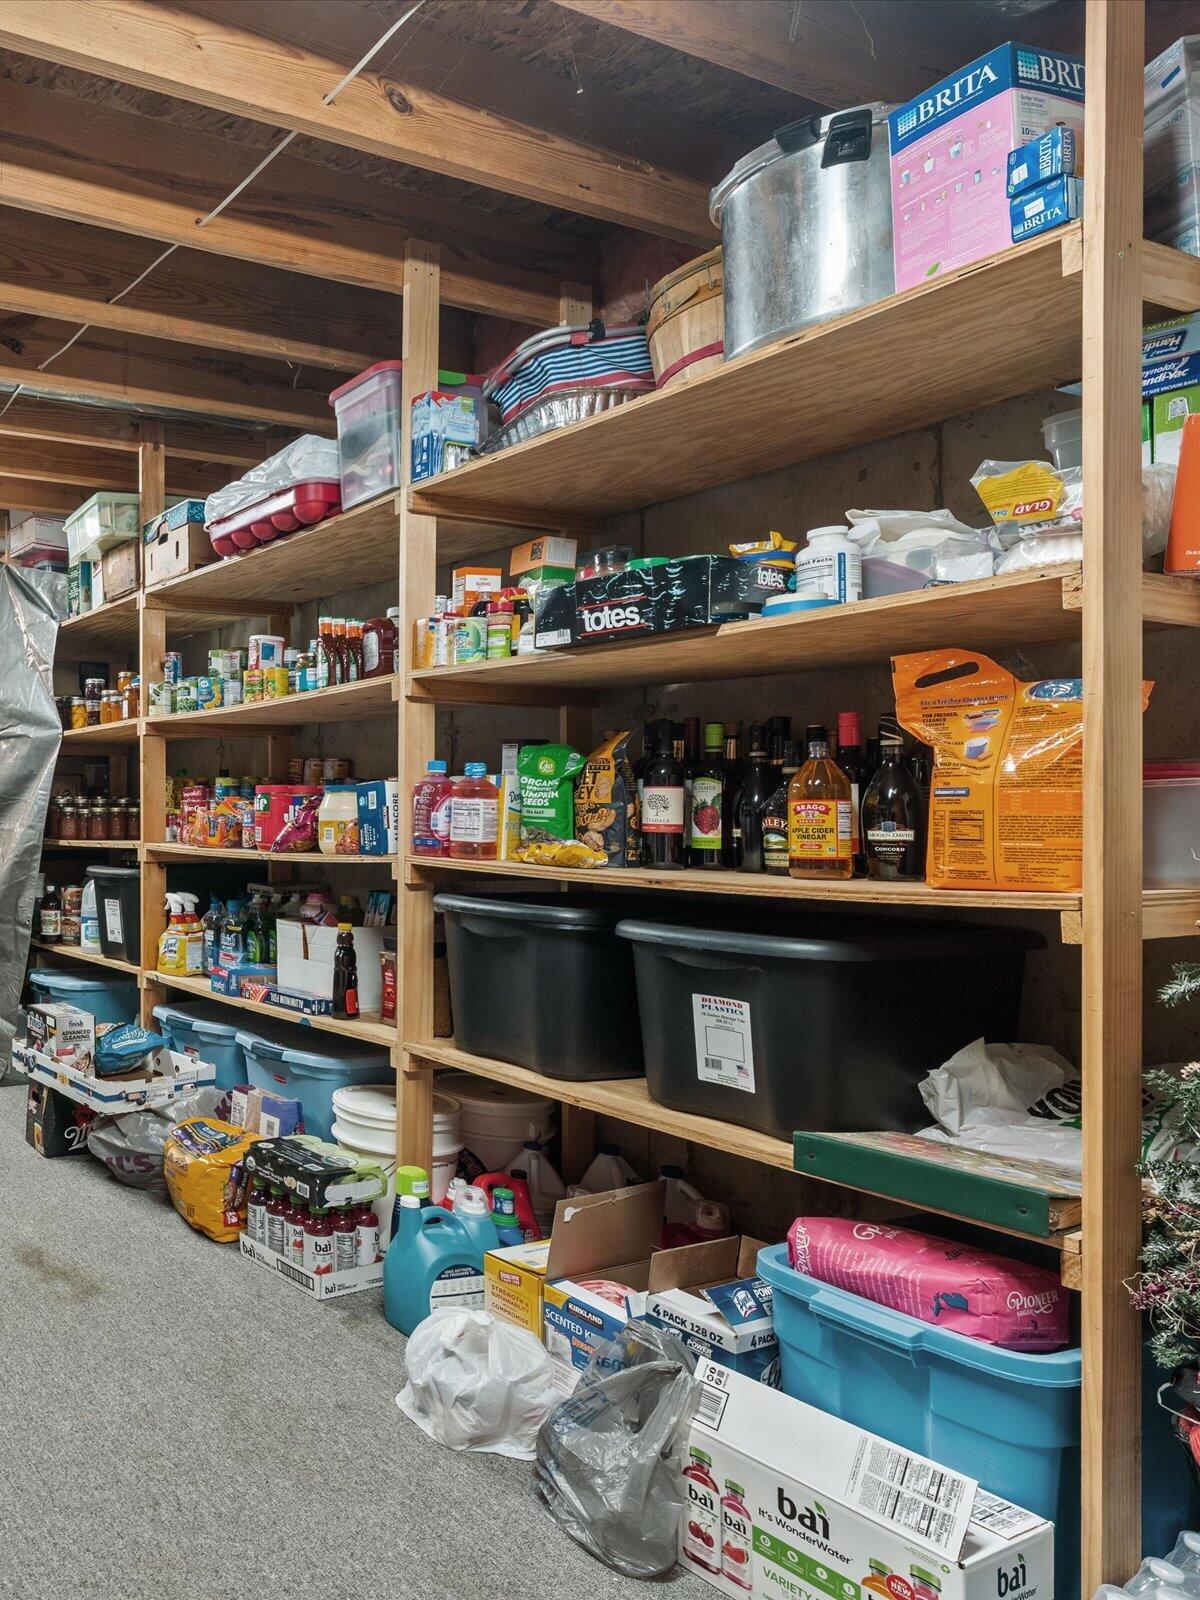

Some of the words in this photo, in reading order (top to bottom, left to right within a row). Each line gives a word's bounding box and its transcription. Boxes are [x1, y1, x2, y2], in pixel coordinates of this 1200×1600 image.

[918, 62, 999, 124] BRITA
[1040, 133, 1052, 171] BRITA
[1064, 130, 1072, 163] BRITA
[1023, 206, 1062, 231] BRITA
[1014, 499, 1052, 515] GLAD
[581, 605, 646, 633] totes.
[521, 790, 559, 799] UMPKIN
[522, 798, 549, 806] SEEDS
[796, 803, 826, 812] BRAGG
[701, 996, 743, 1009] DIAMOND
[701, 1003, 744, 1016] PLASTICS
[61, 1029, 92, 1037] ADVANCED
[242, 1240, 256, 1259] bai
[314, 1239, 332, 1253] bai
[325, 1282, 336, 1295] bai
[491, 1284, 523, 1305] STRENGTH
[1006, 1289, 1060, 1311] PIONEER
[491, 1290, 530, 1314] SUSTAINABILITY
[568, 1302, 603, 1325] KIRKLAND
[491, 1302, 529, 1326] COMPROMISE
[545, 1308, 583, 1336] SCENTED
[652, 1303, 662, 1318] 4
[662, 1311, 689, 1330] PACK
[690, 1322, 708, 1338] 128
[709, 1331, 724, 1346] OZ
[686, 1338, 713, 1356] POWER
[750, 1335, 758, 1349] 4
[757, 1332, 777, 1346] PACK
[688, 1483, 714, 1511] bai
[724, 1511, 747, 1535] bai
[777, 1486, 831, 1541] bai
[758, 1506, 773, 1522] It's
[774, 1517, 852, 1565] WonderWater
[762, 1566, 813, 1600] VARIETY
[891, 1580, 911, 1597] NEW
[997, 1562, 1027, 1598] bai
